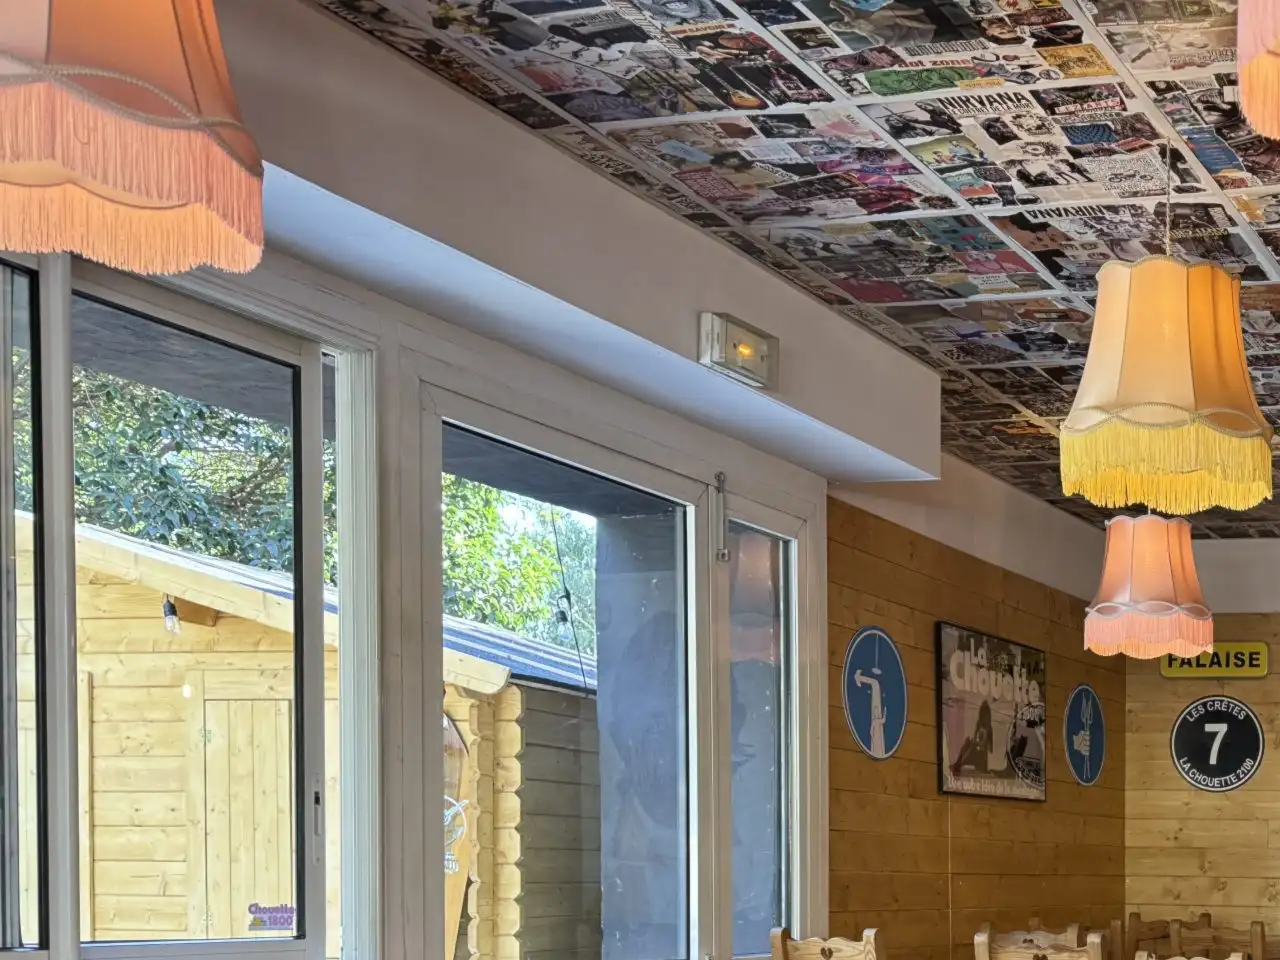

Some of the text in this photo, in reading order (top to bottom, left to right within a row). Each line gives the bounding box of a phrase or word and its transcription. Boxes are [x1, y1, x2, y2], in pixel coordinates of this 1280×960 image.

[935, 91, 1033, 109] NIRVANA
[970, 637, 988, 666] La
[1167, 651, 1262, 668] FALAISE
[949, 648, 1040, 704] Chouette
[1185, 700, 1246, 722] LES CRÊTES
[1204, 723, 1228, 765] 7
[1179, 756, 1255, 787] LA CHOUETTE 2100
